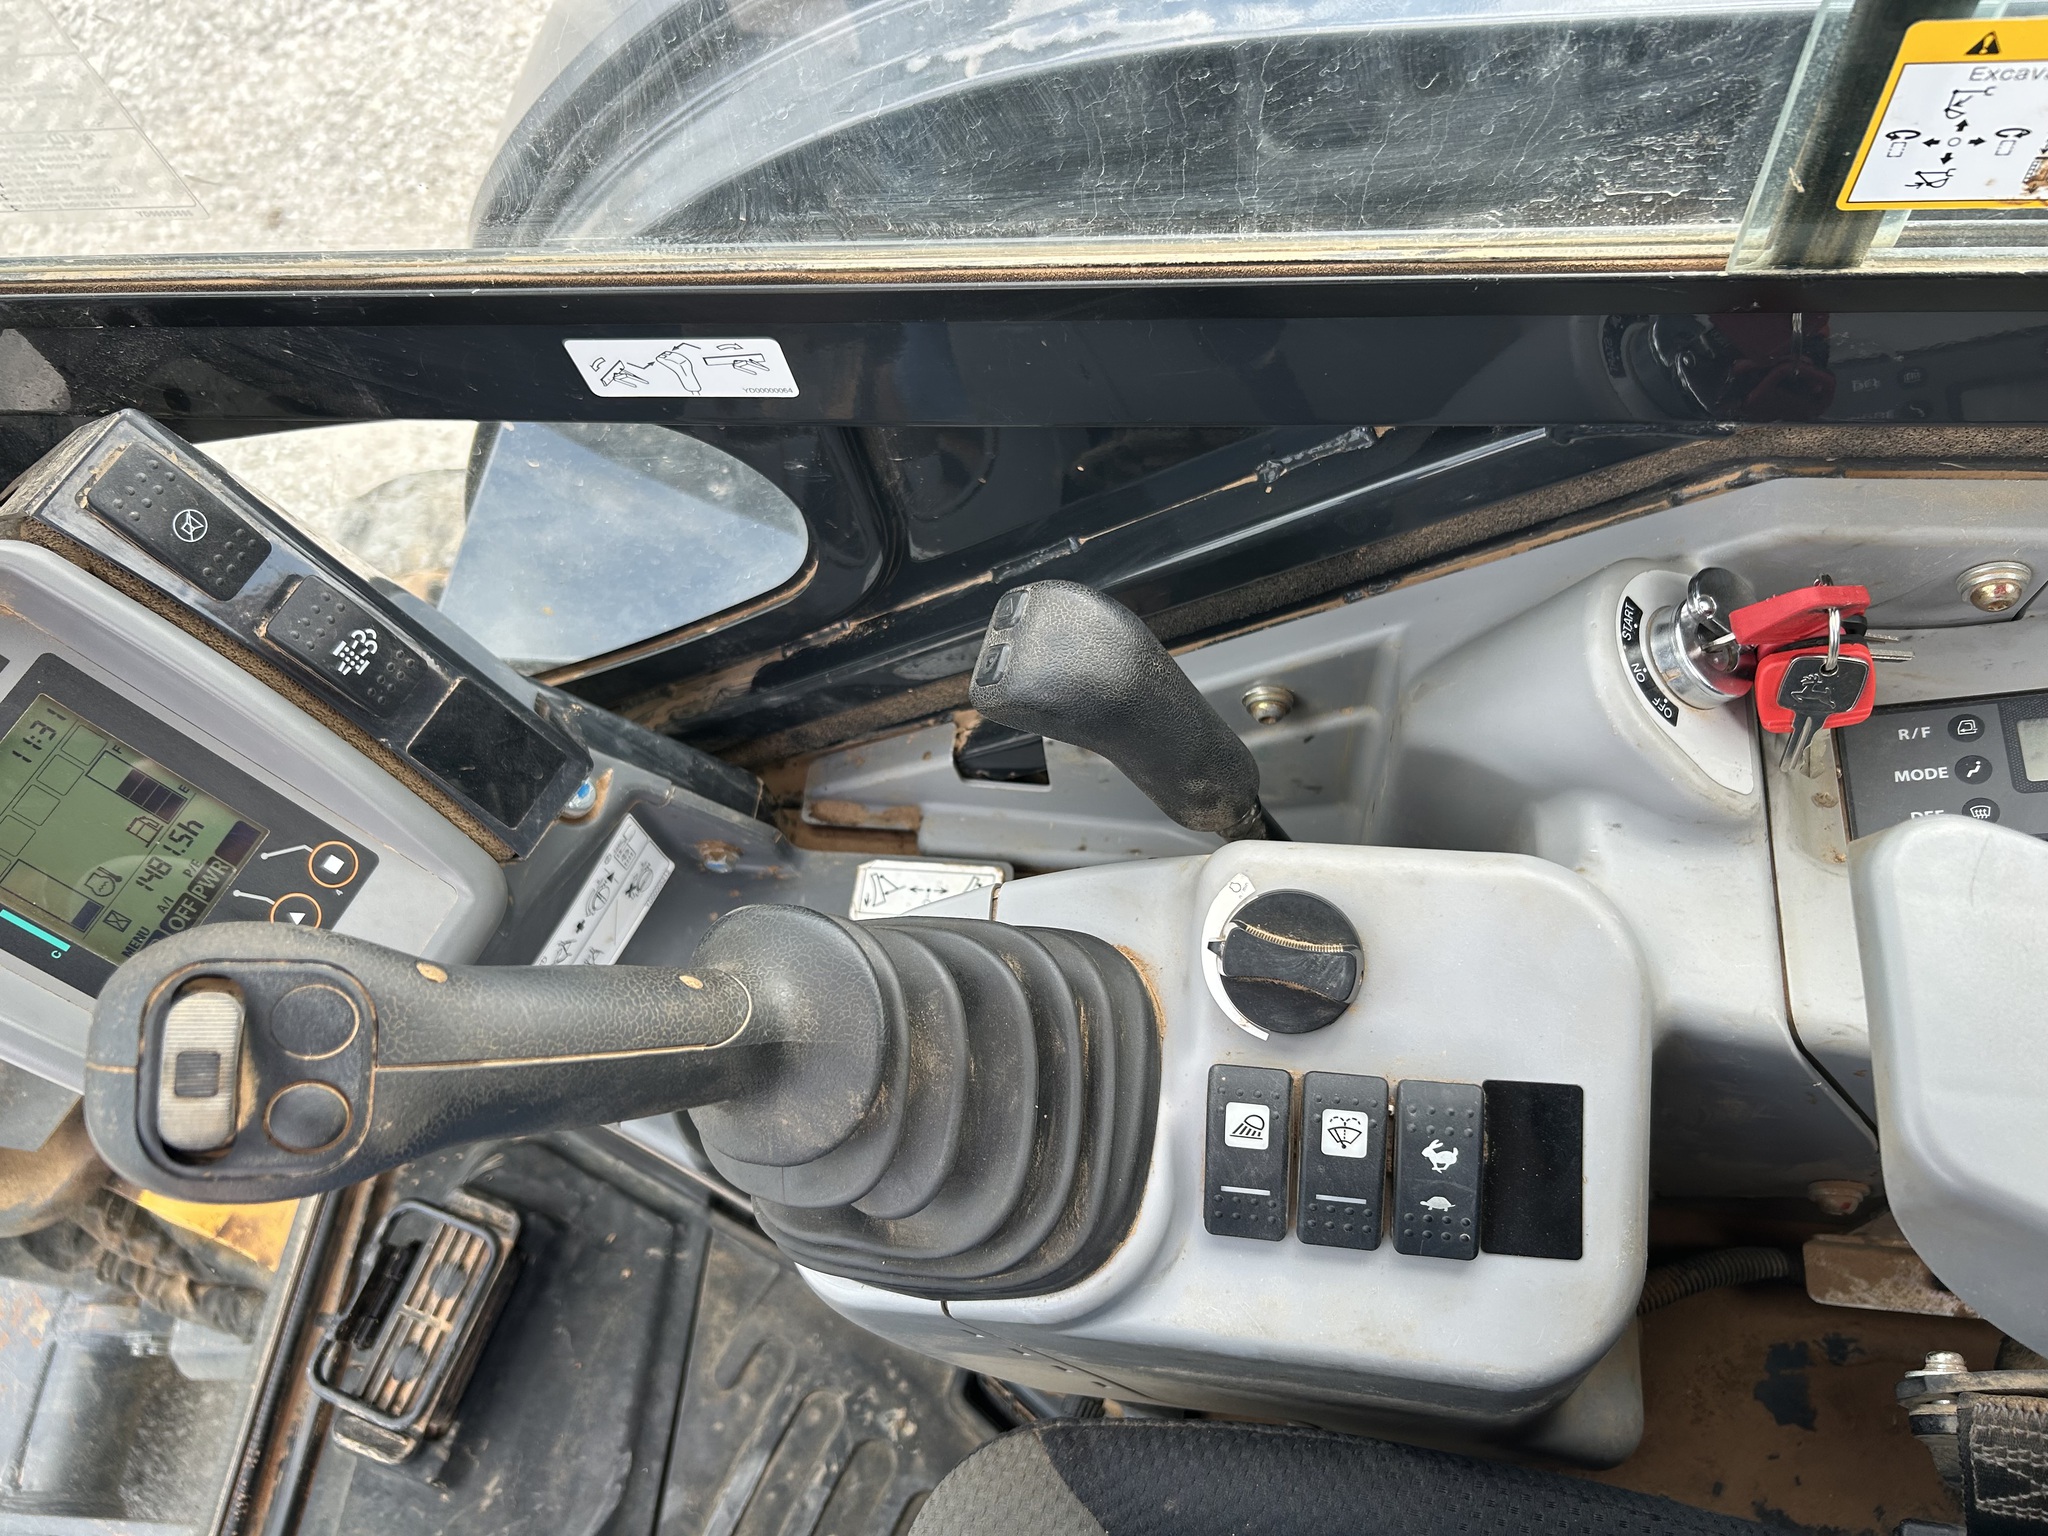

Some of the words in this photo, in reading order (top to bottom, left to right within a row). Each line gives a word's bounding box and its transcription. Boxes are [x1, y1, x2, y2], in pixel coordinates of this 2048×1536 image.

[1968, 66, 2048, 81] Excav
[1622, 602, 1634, 641] START
[1631, 662, 1646, 683] ON
[1652, 697, 1673, 719] OFF
[12, 708, 67, 763] 11:31
[1897, 726, 1931, 741] R/F
[111, 744, 122, 755] F
[1894, 766, 1949, 783] MODE
[178, 784, 190, 794] E
[182, 859, 203, 878] P/E
[191, 860, 231, 899] PWR
[168, 898, 198, 931] OFF
[121, 926, 151, 958] MENU
